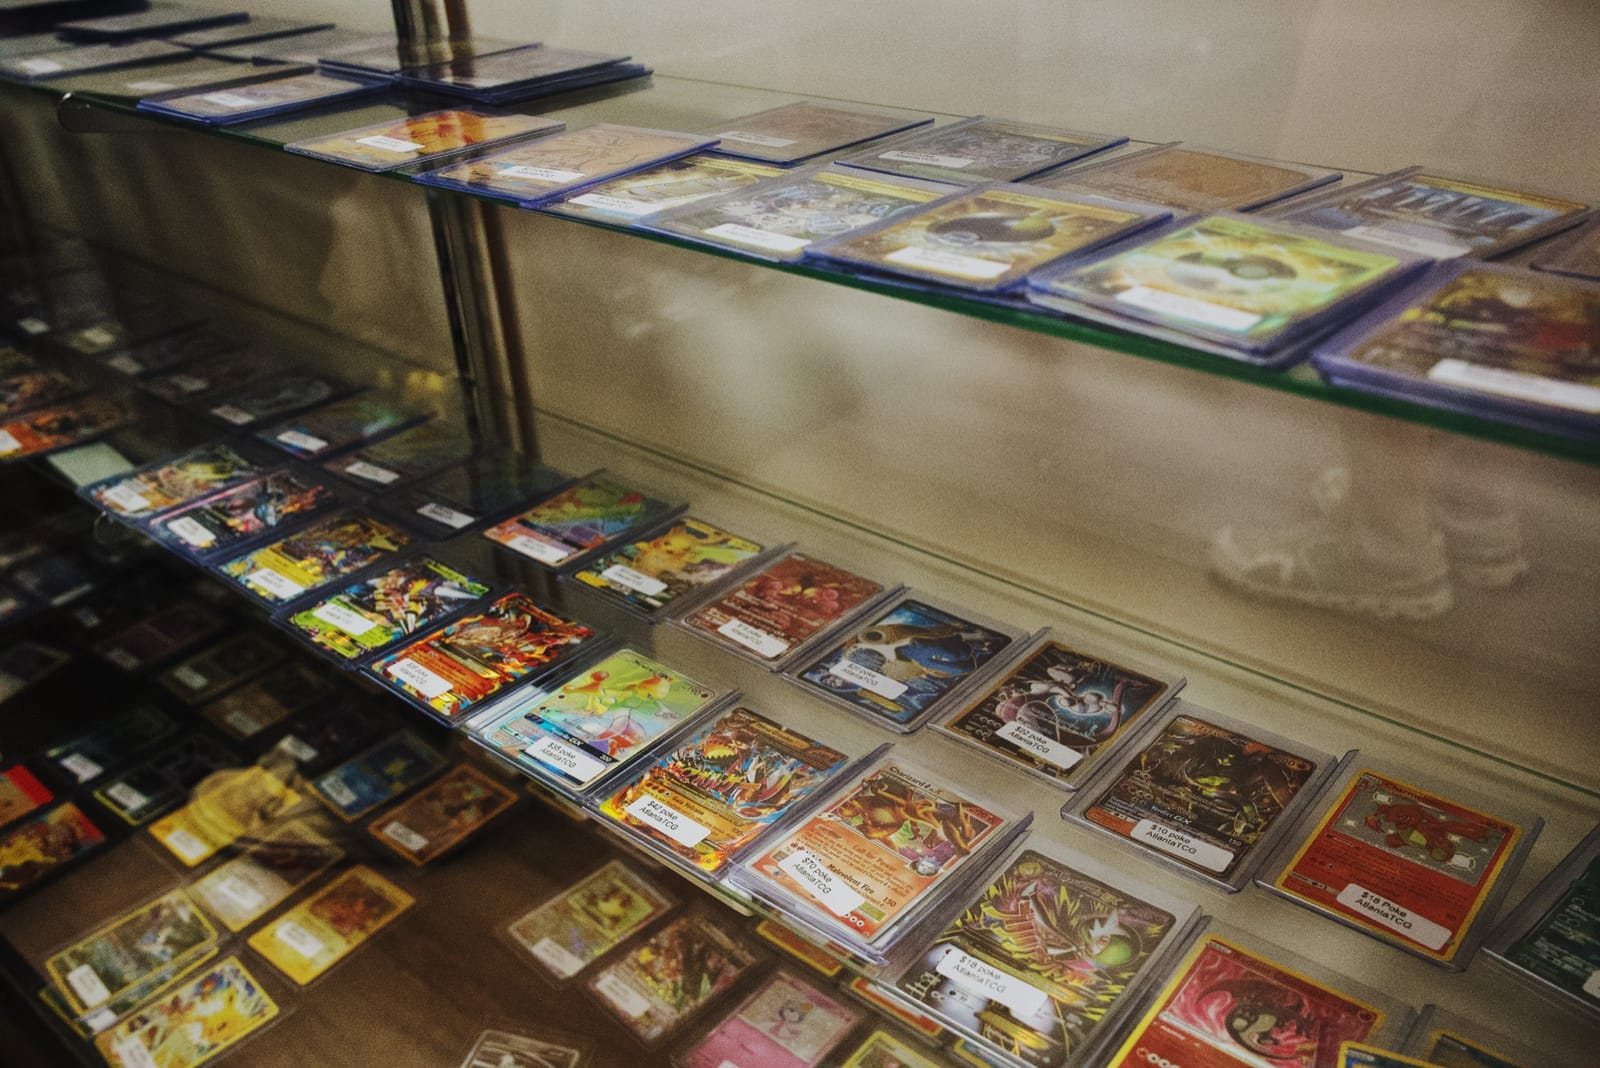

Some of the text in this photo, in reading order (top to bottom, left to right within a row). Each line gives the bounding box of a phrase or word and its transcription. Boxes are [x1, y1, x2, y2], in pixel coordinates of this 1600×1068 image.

[1008, 731, 1050, 754] AtlantaTCG
[1028, 734, 1048, 745] poke
[541, 746, 577, 768] AtlantaTCG
[559, 749, 576, 760] poke
[639, 806, 679, 831] AtlantaTCG
[647, 800, 678, 820] $42 poke
[1145, 830, 1197, 855] AtlantaTCG
[1151, 823, 1191, 845] $10 poke
[792, 862, 832, 895] AtlantaTCG
[802, 856, 832, 883] $70 poke
[826, 863, 875, 896] Malevolent Fire
[882, 896, 897, 908] 150
[1381, 901, 1407, 918] Poke
[1355, 899, 1413, 930] AtlantaTCG
[953, 963, 1006, 994] AtlantaTCG
[959, 955, 1001, 980] $18 poke
